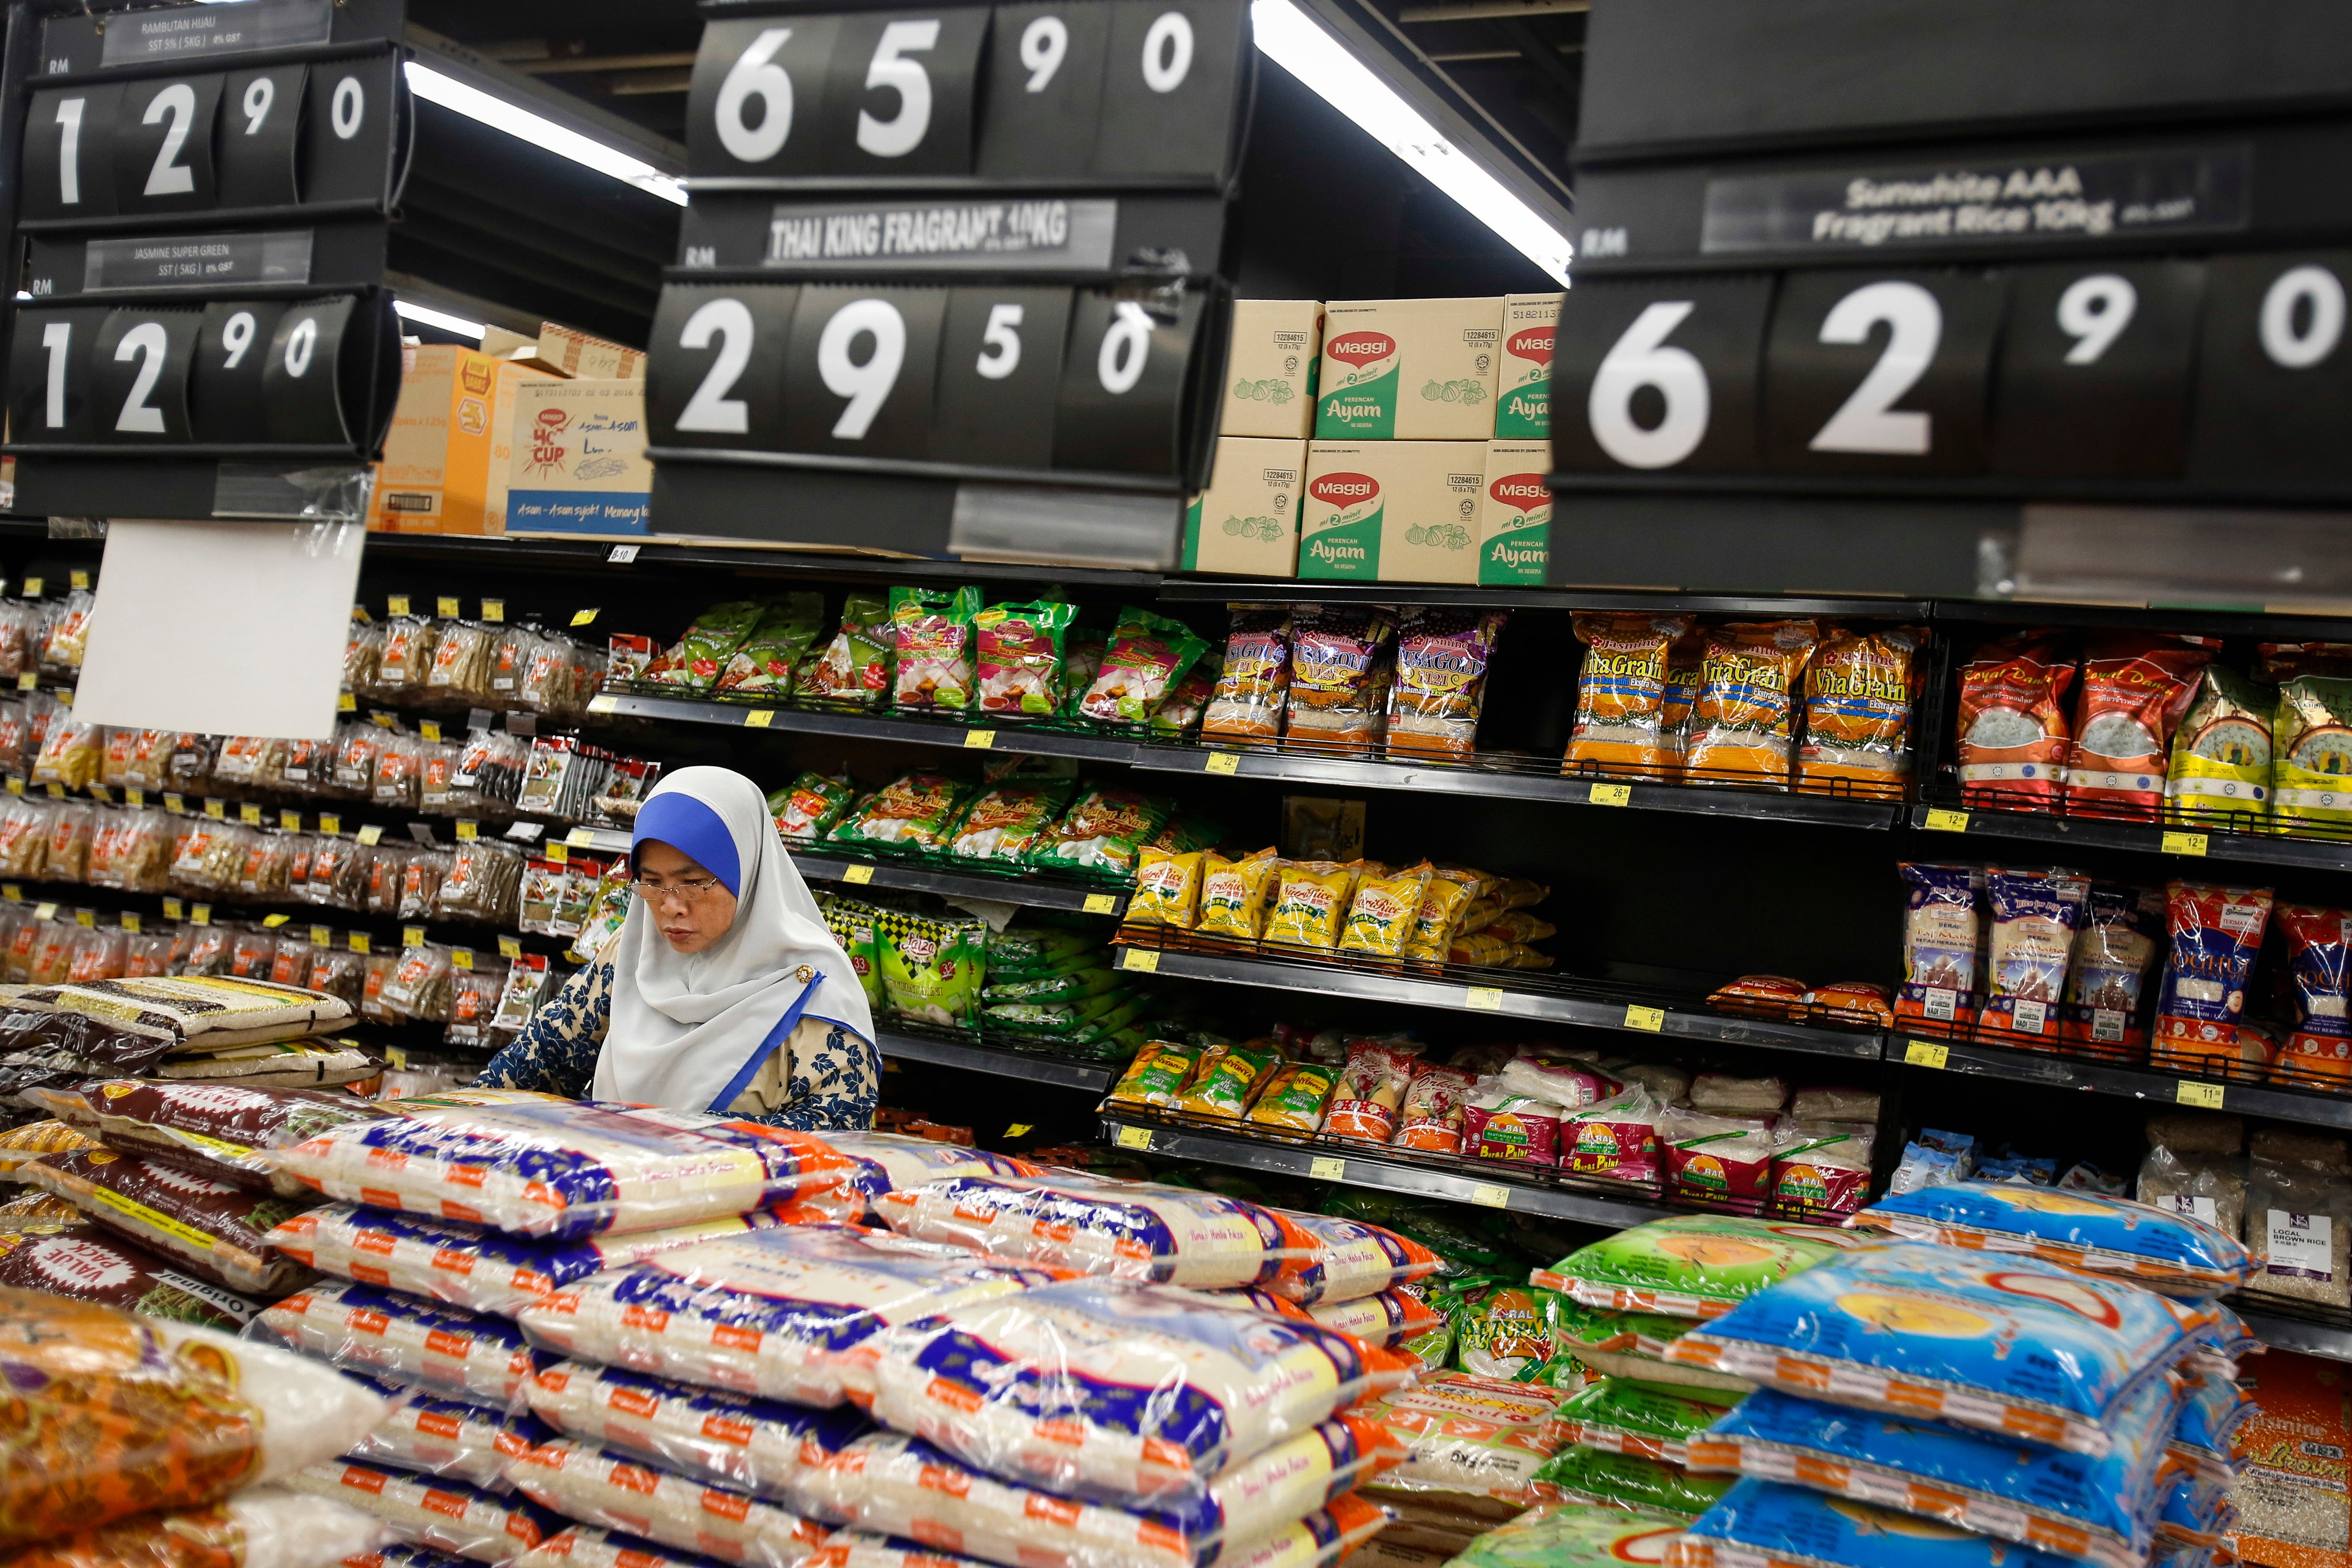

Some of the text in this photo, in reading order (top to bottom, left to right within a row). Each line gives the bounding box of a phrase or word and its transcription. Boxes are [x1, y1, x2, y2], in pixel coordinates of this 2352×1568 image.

[142, 19, 190, 34] RAMBUTAN
[149, 39, 162, 52] SST
[49, 59, 68, 74] RM
[771, 217, 822, 261] THAI
[824, 213, 879, 257] KING
[883, 205, 1004, 254] FRAGRANT
[135, 244, 229, 259] JASMINE SUPER GREEN
[686, 246, 714, 267] RM
[33, 279, 51, 294] RM
[1277, 333, 1304, 341] 12284615
[1335, 341, 1387, 354] Maggi
[1359, 367, 1378, 379] minit
[1327, 399, 1381, 422] Ayam
[534, 447, 565, 463] CUP
[1267, 472, 1293, 480] 12284615
[1318, 482, 1370, 496] Maggi
[1319, 509, 1361, 527] mi minit
[1501, 510, 1547, 529] mi minit
[611, 550, 628, 559] B-10
[1310, 540, 1365, 563] Ayam
[1238, 632, 1272, 641] Jasmine
[1316, 633, 1359, 645] Jasmine
[1424, 637, 1468, 649] Jasmine
[1603, 639, 1659, 650] Jasmine
[1838, 651, 1896, 666] Jasmine
[1309, 666, 1336, 680] 1121
[1418, 671, 1448, 686] 1121
[1251, 677, 1274, 688] Panjang
[1297, 681, 1337, 691] Basmathi Ekstra
[1631, 677, 1650, 687] Ekstra
[1431, 689, 1450, 697] Ekstra
[1753, 687, 1774, 699] Ekstra
[1869, 700, 1890, 710] Ekstra
[1117, 811, 1151, 830] Nasi
[1284, 884, 1333, 900] NutriRice
[2016, 899, 2034, 909] Rice
[900, 930, 936, 957] faiza
[854, 957, 866, 969] 33
[1927, 1007, 1939, 1015] NADI
[2016, 1020, 2028, 1028] NADI
[2095, 1028, 2108, 1037] NADI
[1224, 1058, 1252, 1079] NYONYA
[1295, 1076, 1324, 1092] NYONYA
[1416, 1075, 1469, 1094] Orkid
[1489, 1121, 1525, 1134] FLORAL
[1580, 1133, 1614, 1143] FLORAL
[1480, 1144, 1529, 1159] Beras Pulut
[1573, 1155, 1620, 1172] Beras Pulut
[1686, 1163, 1724, 1179] FLORAL
[1785, 1175, 1823, 1188] FLORAL
[2273, 1229, 2301, 1237] LOCAL
[2273, 1234, 2305, 1243] BROWN
[68, 1243, 120, 1270] PACK
[1348, 1252, 1375, 1264] Herba Faiza
[43, 1248, 105, 1283] VALUE
[158, 1273, 244, 1313] Original
[1349, 1313, 1376, 1328] Herba Faiza
[1487, 1307, 1534, 1320] FLORAL
[2250, 1412, 2327, 1437] Jasmine
